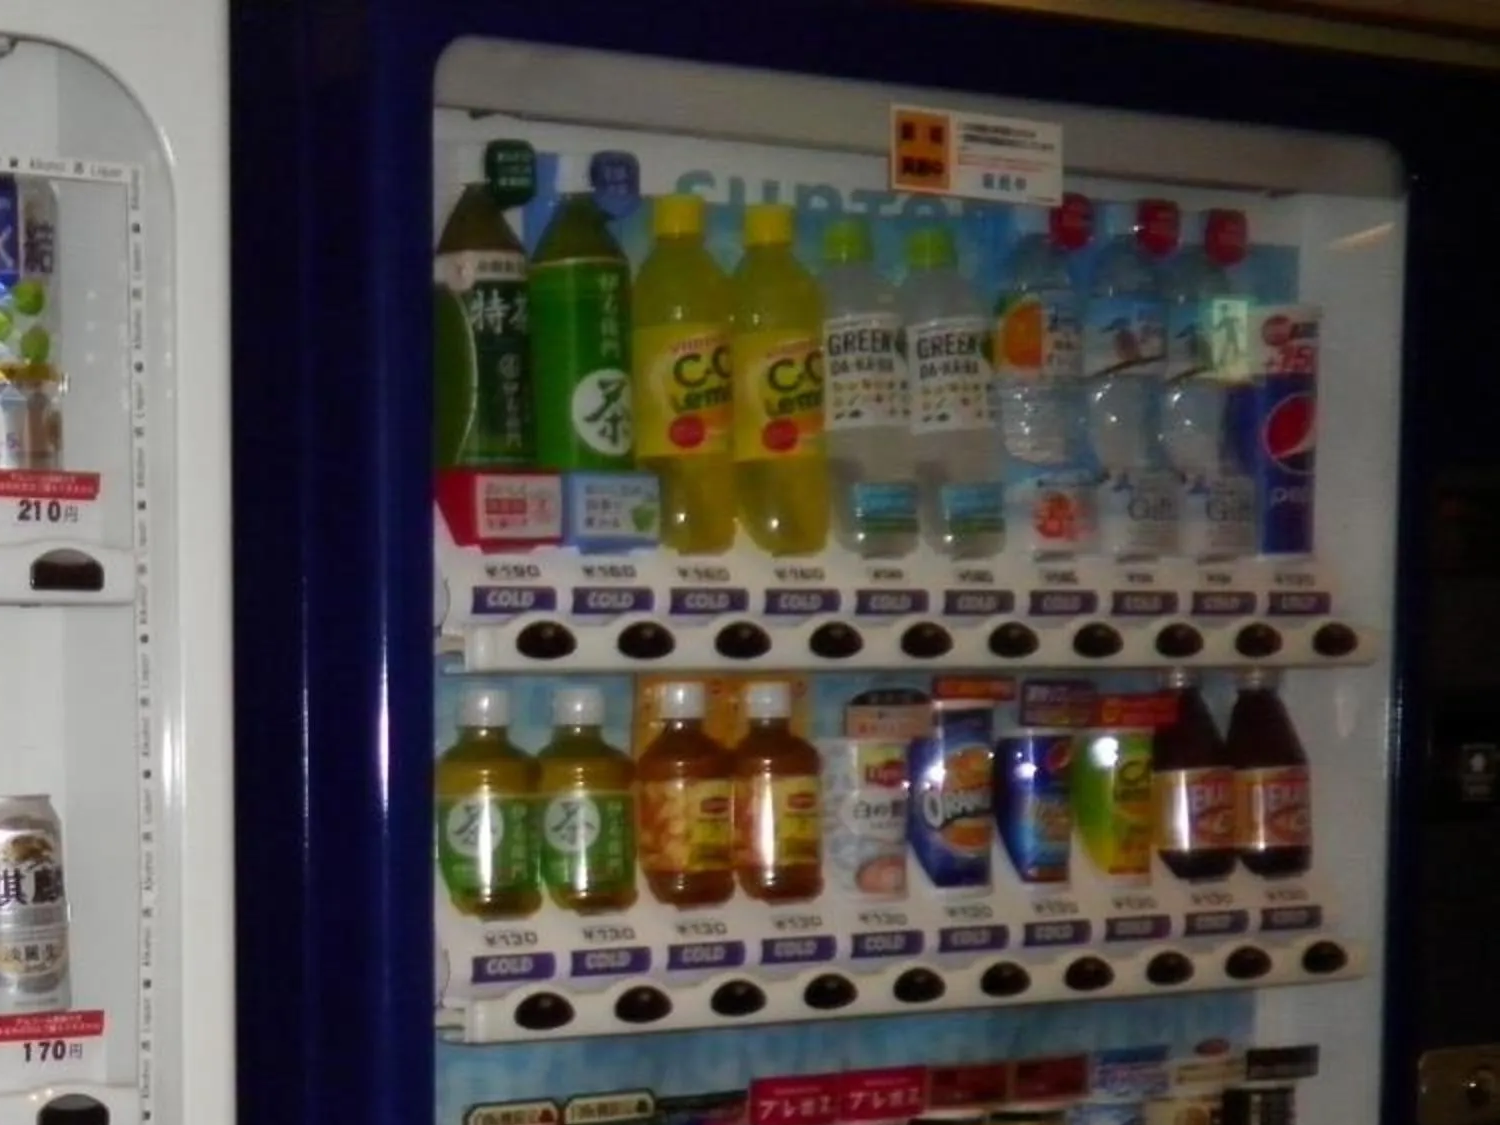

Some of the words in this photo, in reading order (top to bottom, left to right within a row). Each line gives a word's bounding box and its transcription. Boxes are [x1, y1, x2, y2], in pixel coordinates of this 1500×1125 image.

[827, 328, 891, 357] GREEN
[916, 332, 977, 359] GREEN
[17, 499, 79, 523] 210円
[486, 590, 535, 608] COLD
[587, 590, 635, 609] COLD
[684, 591, 730, 610] COLD
[779, 592, 824, 610] COLD
[584, 951, 632, 970] COLD
[681, 945, 726, 963] COLD
[486, 959, 533, 975] COLD
[22, 1039, 84, 1063] 170円
